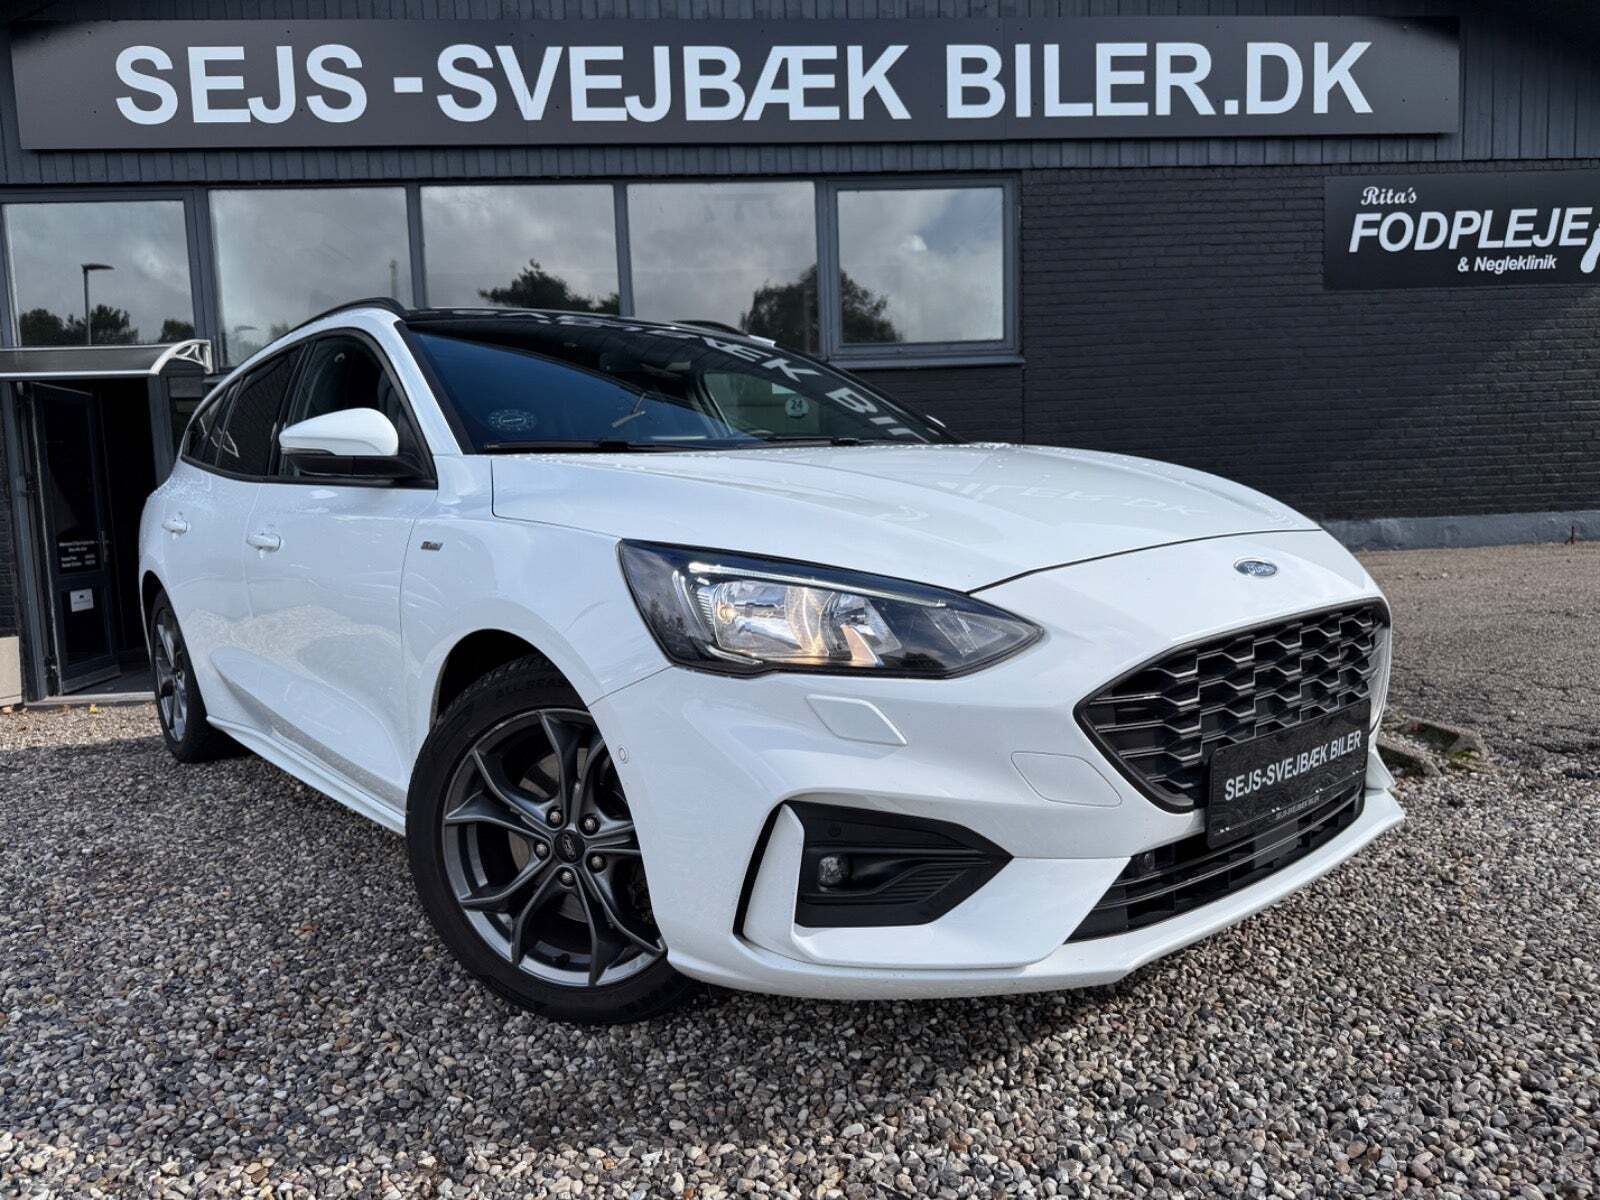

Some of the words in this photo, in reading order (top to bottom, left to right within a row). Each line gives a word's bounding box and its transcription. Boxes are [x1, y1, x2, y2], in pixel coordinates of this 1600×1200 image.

[946, 42, 1374, 118] BILER.DK
[1348, 207, 1593, 253] FODPLEJE
[1457, 256, 1470, 273] &
[1473, 255, 1558, 275] Negleklinik
[1223, 743, 1328, 801] SEJS-SVEJBÆK
[1329, 730, 1363, 761] BILER
